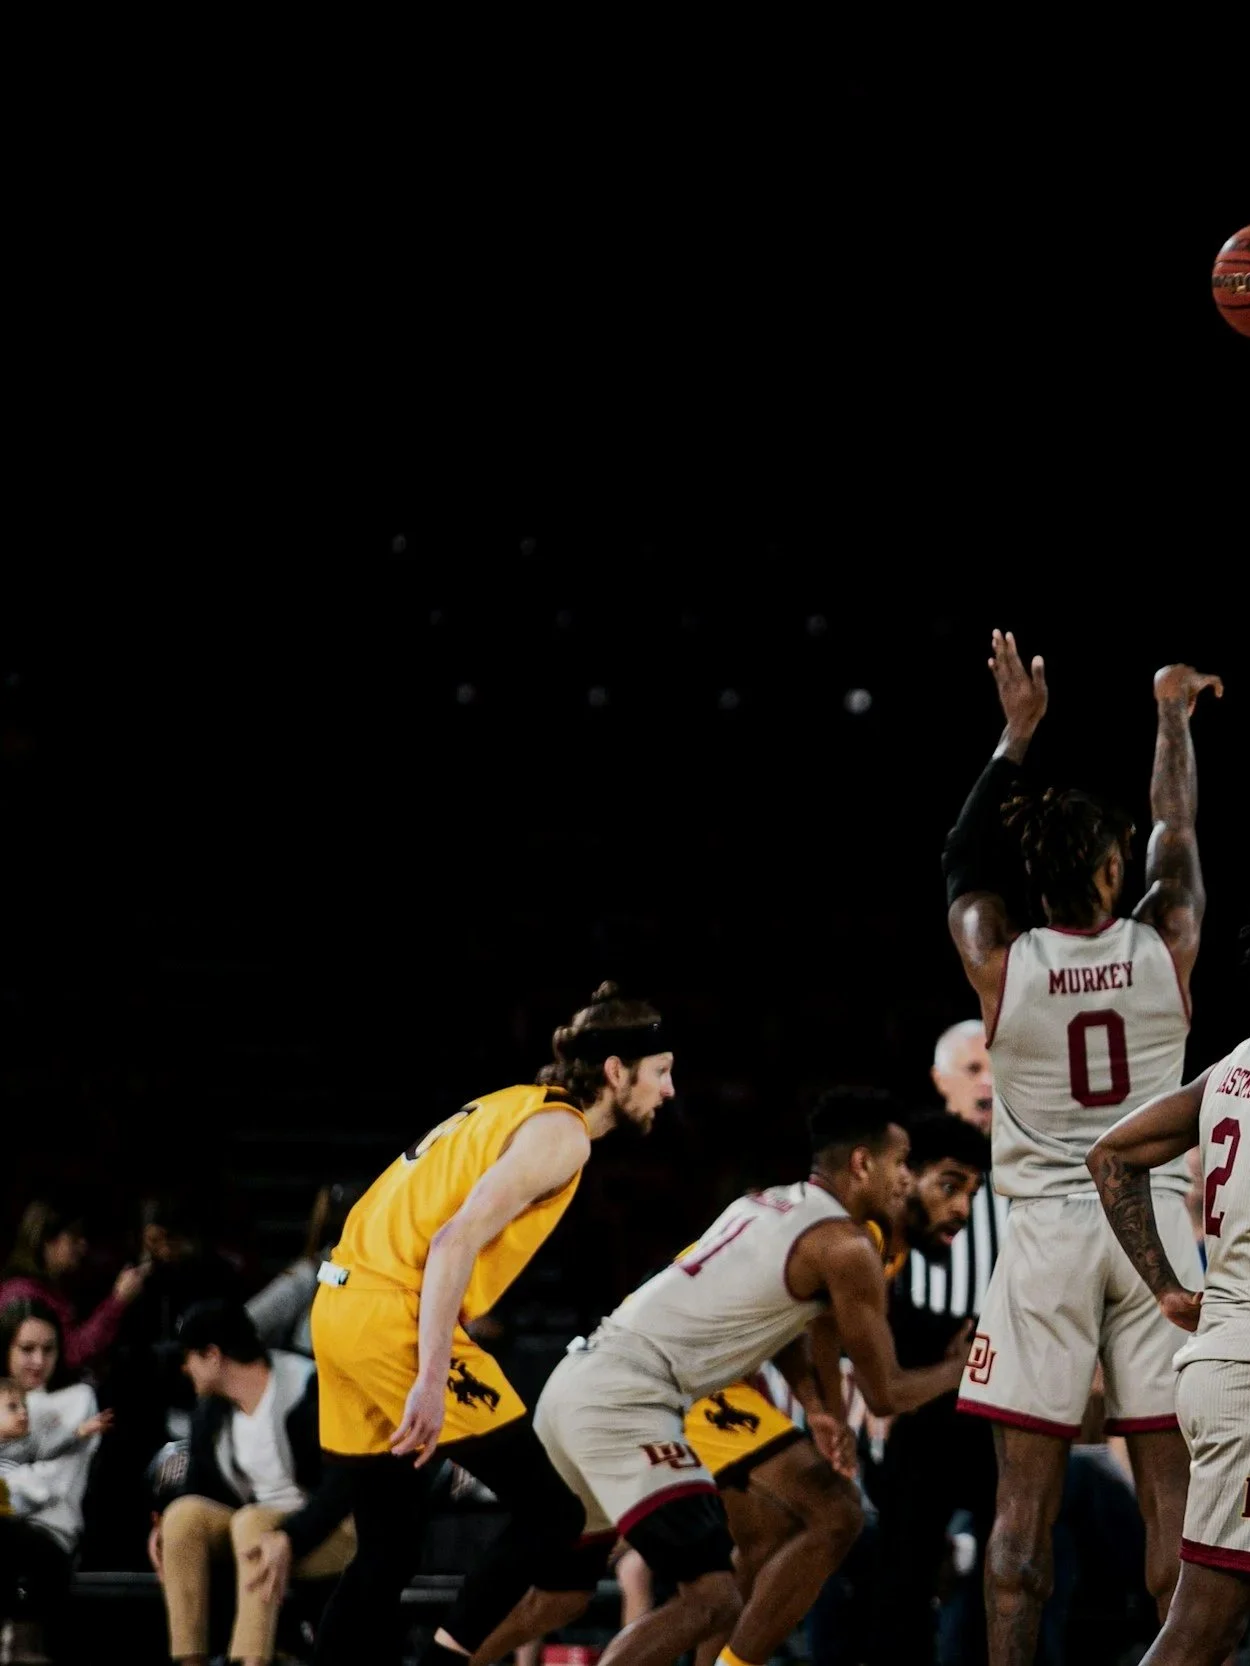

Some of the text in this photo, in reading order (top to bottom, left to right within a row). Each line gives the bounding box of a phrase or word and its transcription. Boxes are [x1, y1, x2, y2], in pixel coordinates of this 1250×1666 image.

[1048, 960, 1134, 996] MURKEY
[1068, 1008, 1130, 1107] 0
[1205, 1117, 1241, 1238] 2
[967, 1333, 997, 1384] DU
[640, 1441, 702, 1469] DU
